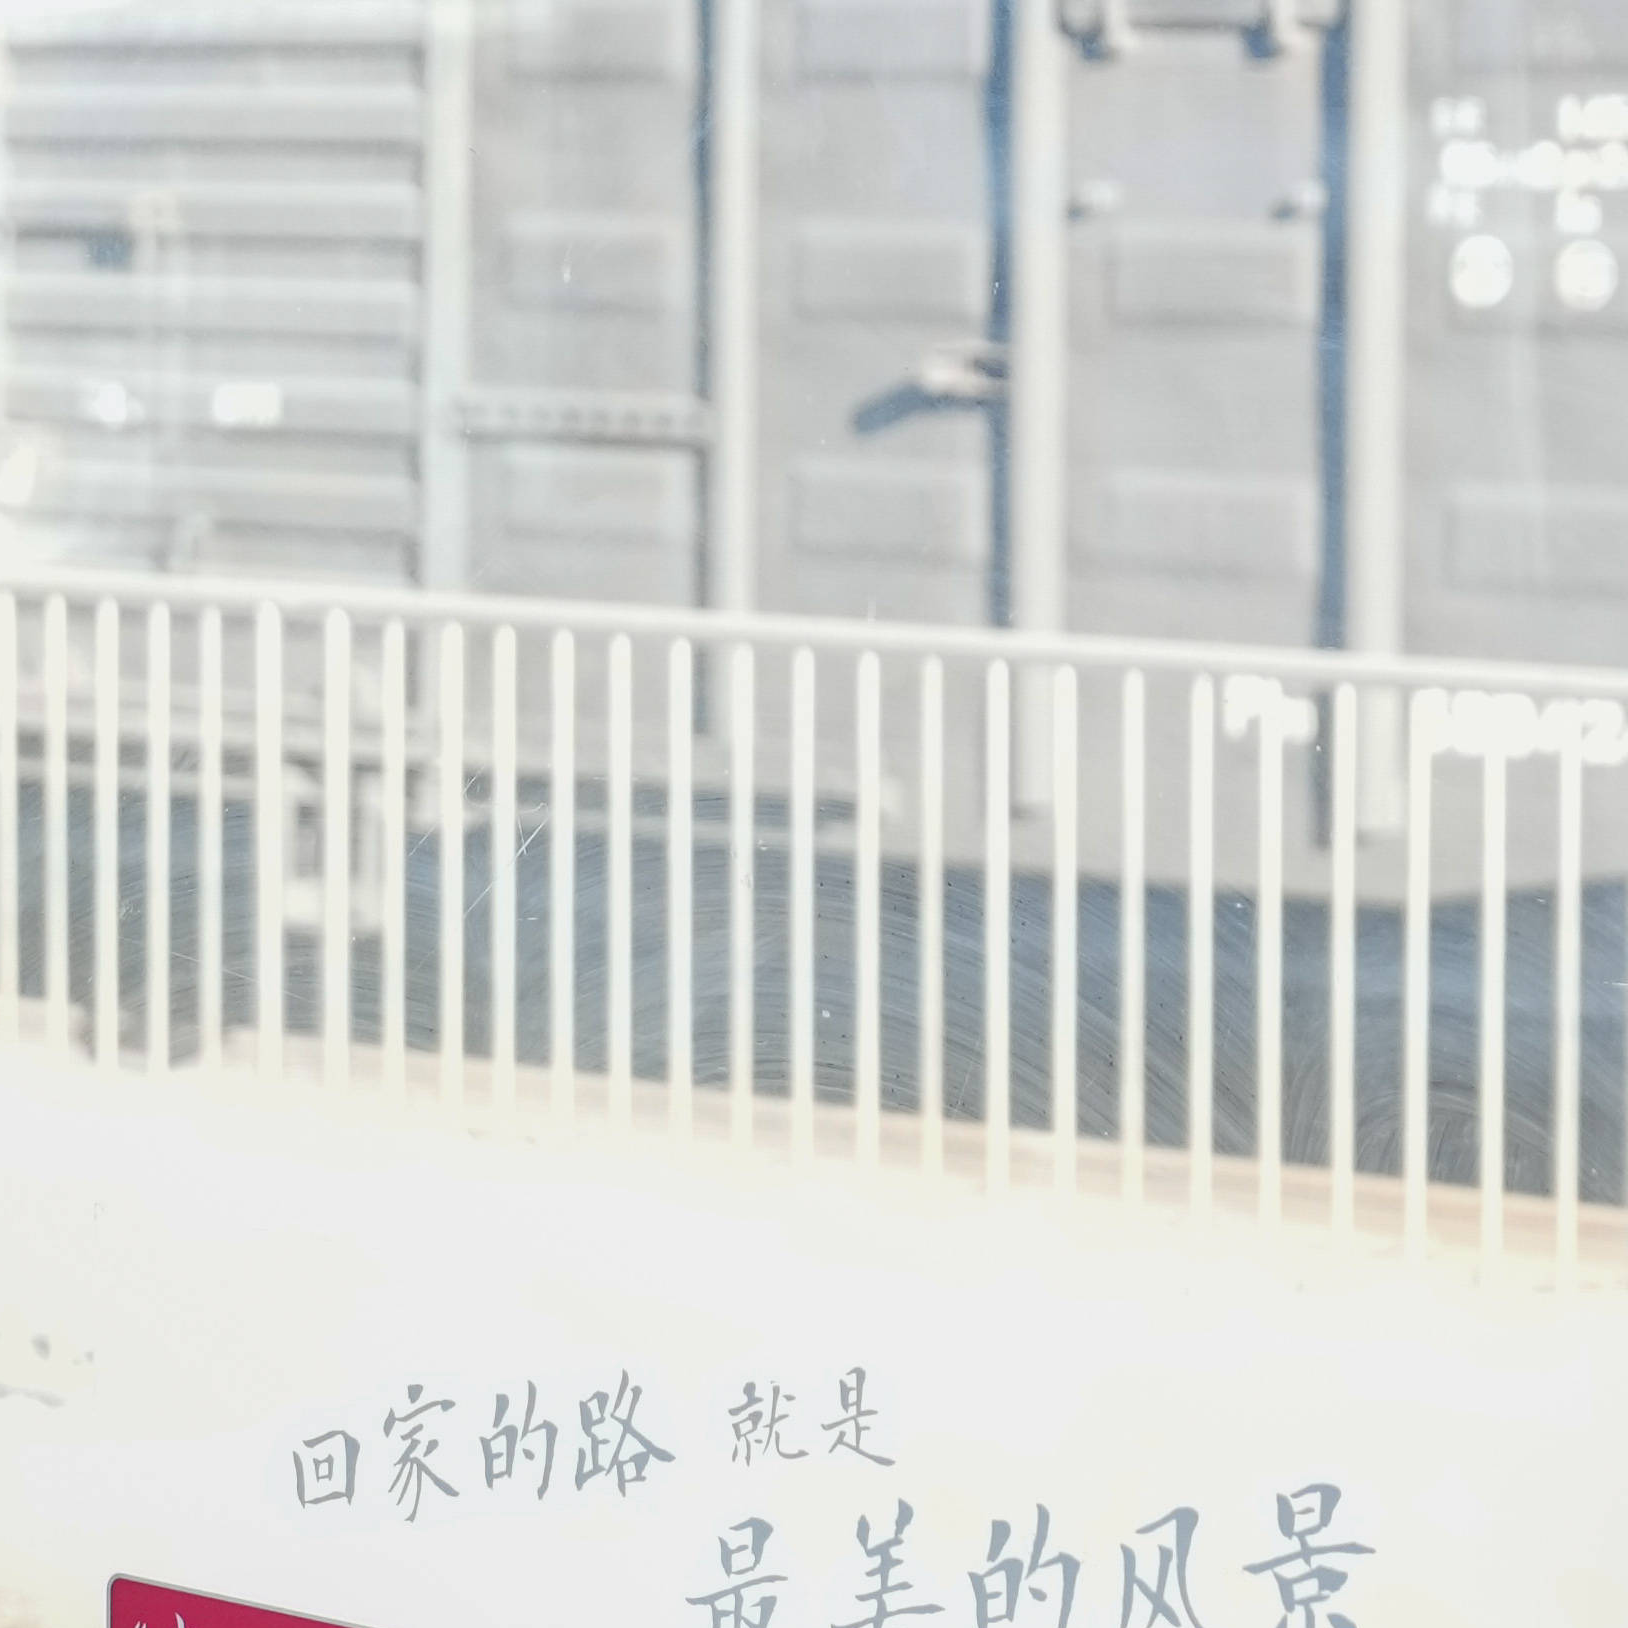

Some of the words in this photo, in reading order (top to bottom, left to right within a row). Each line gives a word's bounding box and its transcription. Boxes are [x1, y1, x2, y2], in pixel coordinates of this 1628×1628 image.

[290, 1369, 676, 1522] 回家的路
[727, 1367, 896, 1468] 就是
